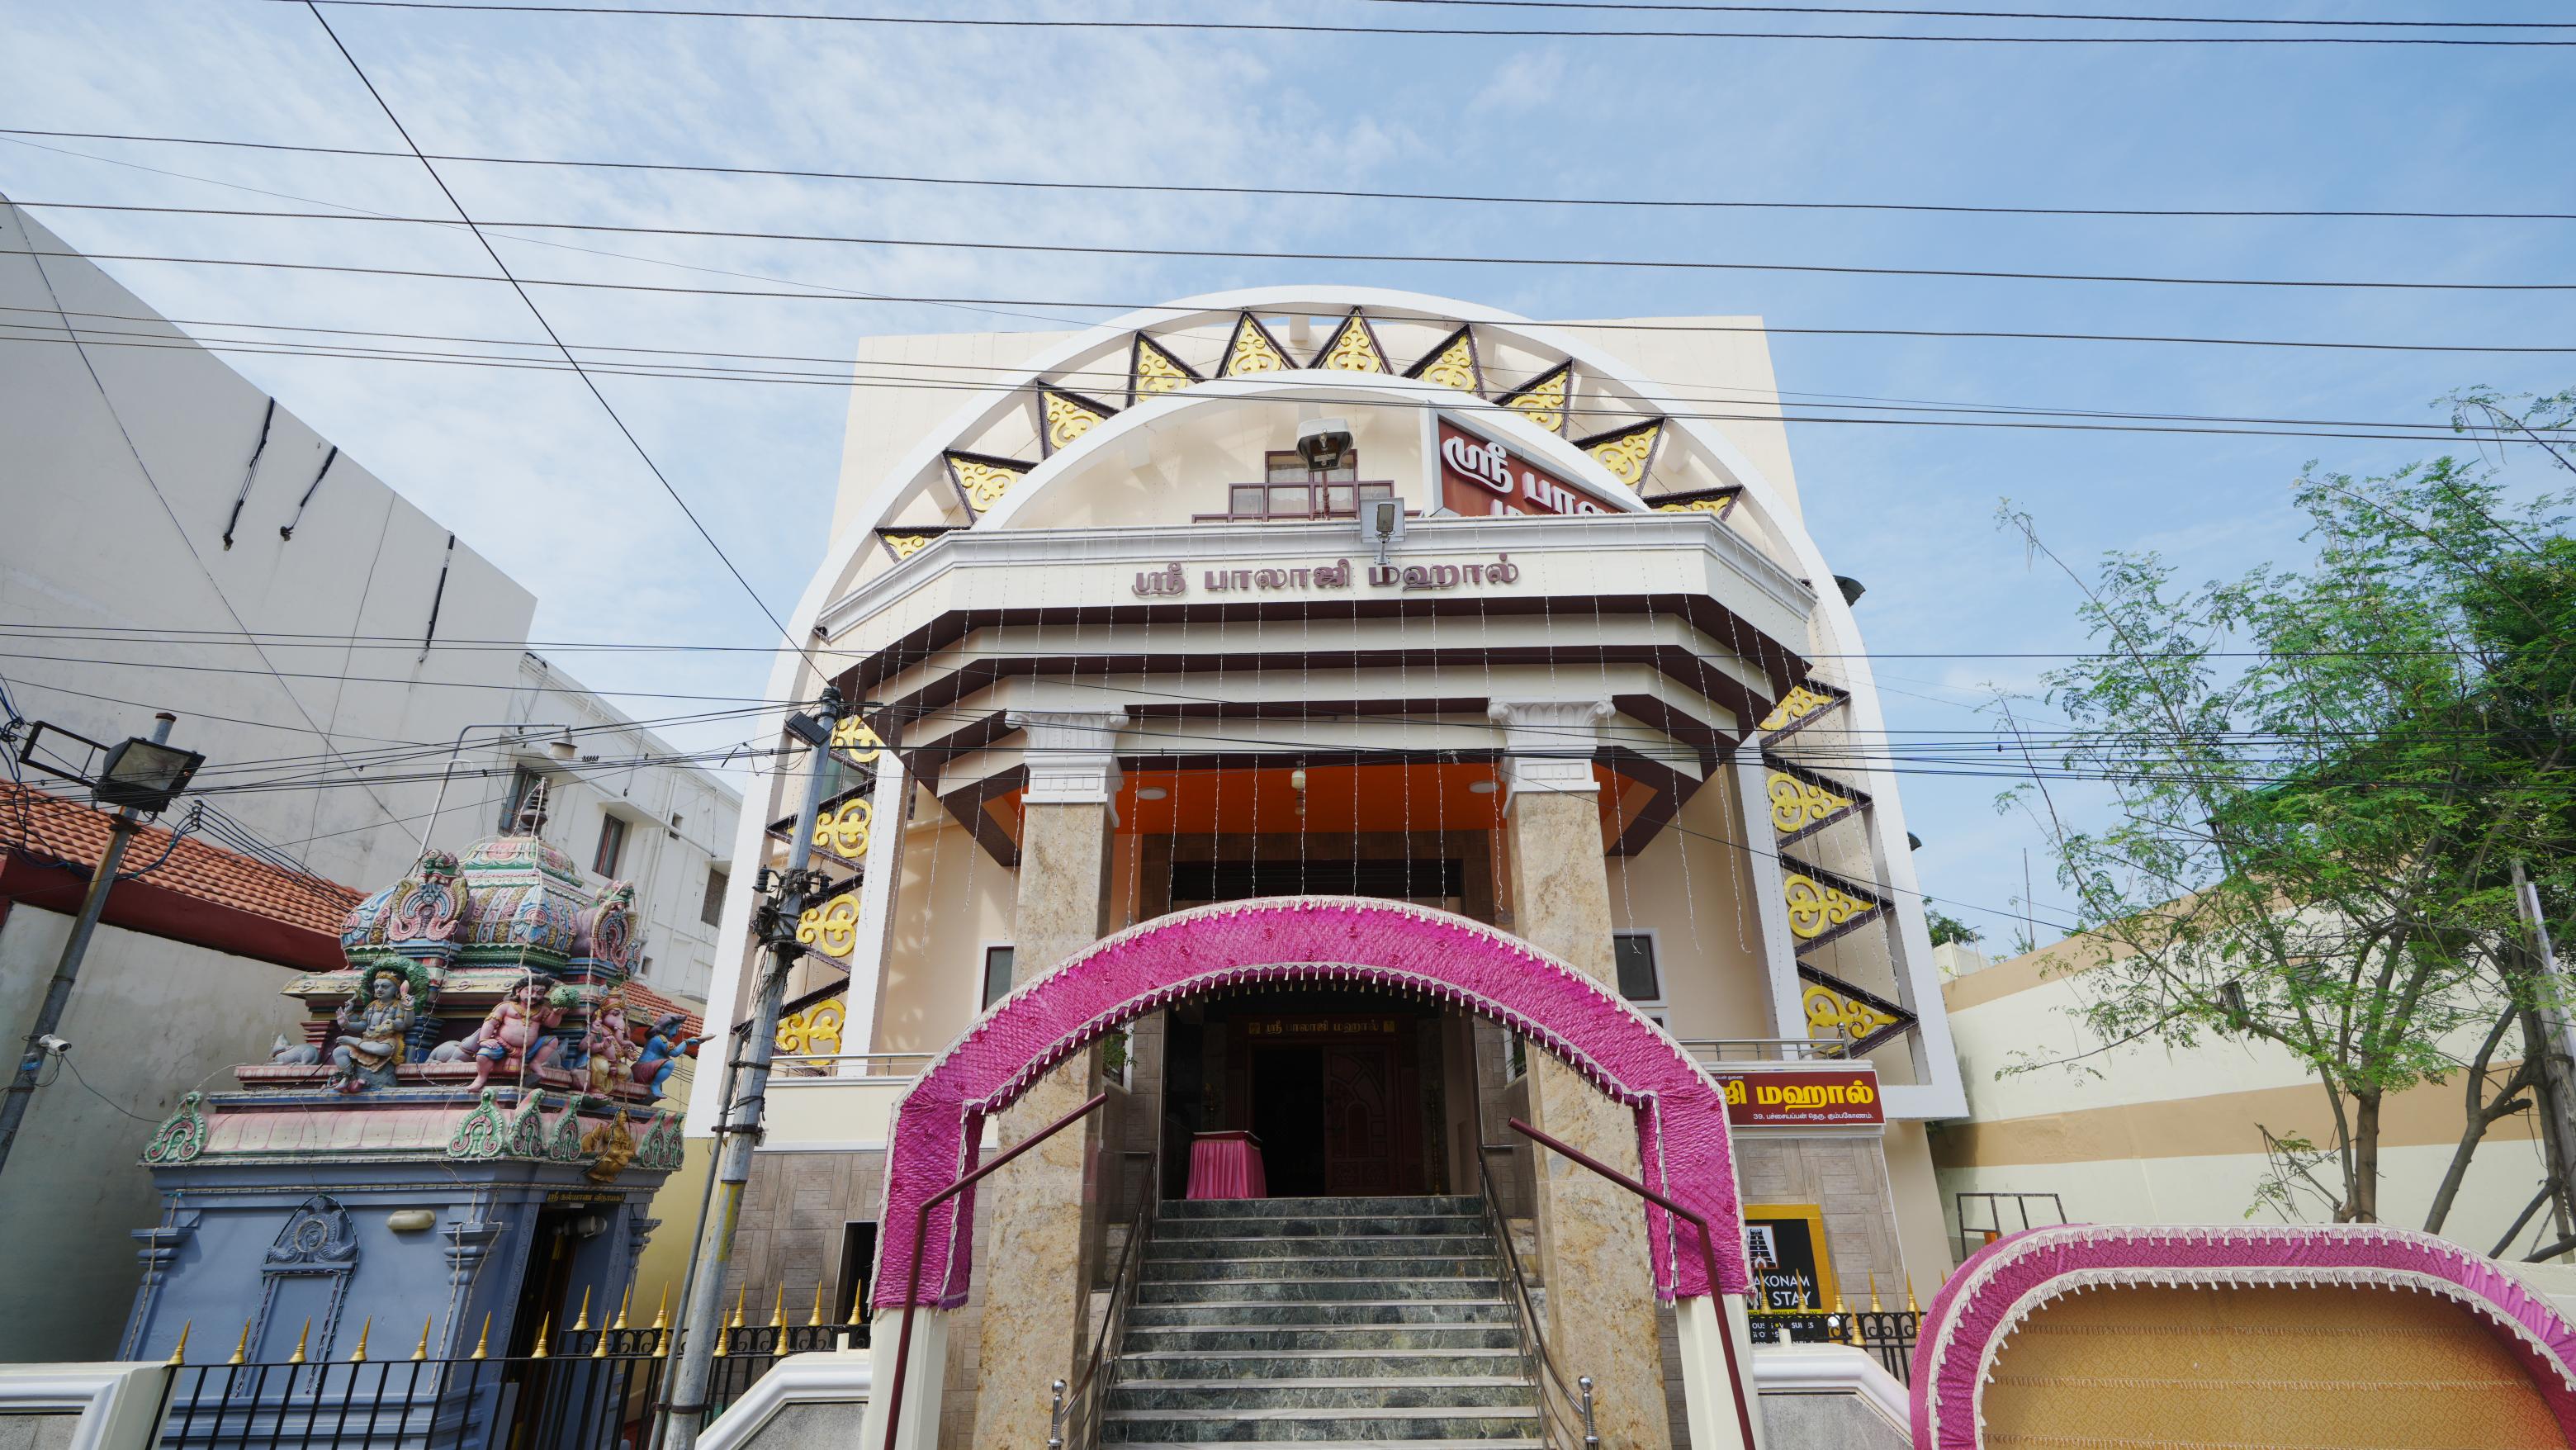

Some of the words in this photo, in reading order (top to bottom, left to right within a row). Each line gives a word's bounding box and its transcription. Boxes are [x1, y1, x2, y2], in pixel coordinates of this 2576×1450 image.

[1203, 558, 1352, 590] பாலாஜி
[1367, 552, 1519, 591] மஹால்
[1724, 1080, 1748, 1105] ஜி
[1756, 1079, 1874, 1113] மஹால்
[1754, 1275, 1811, 1287] AKONAM
[1773, 1291, 1811, 1306] STAY
